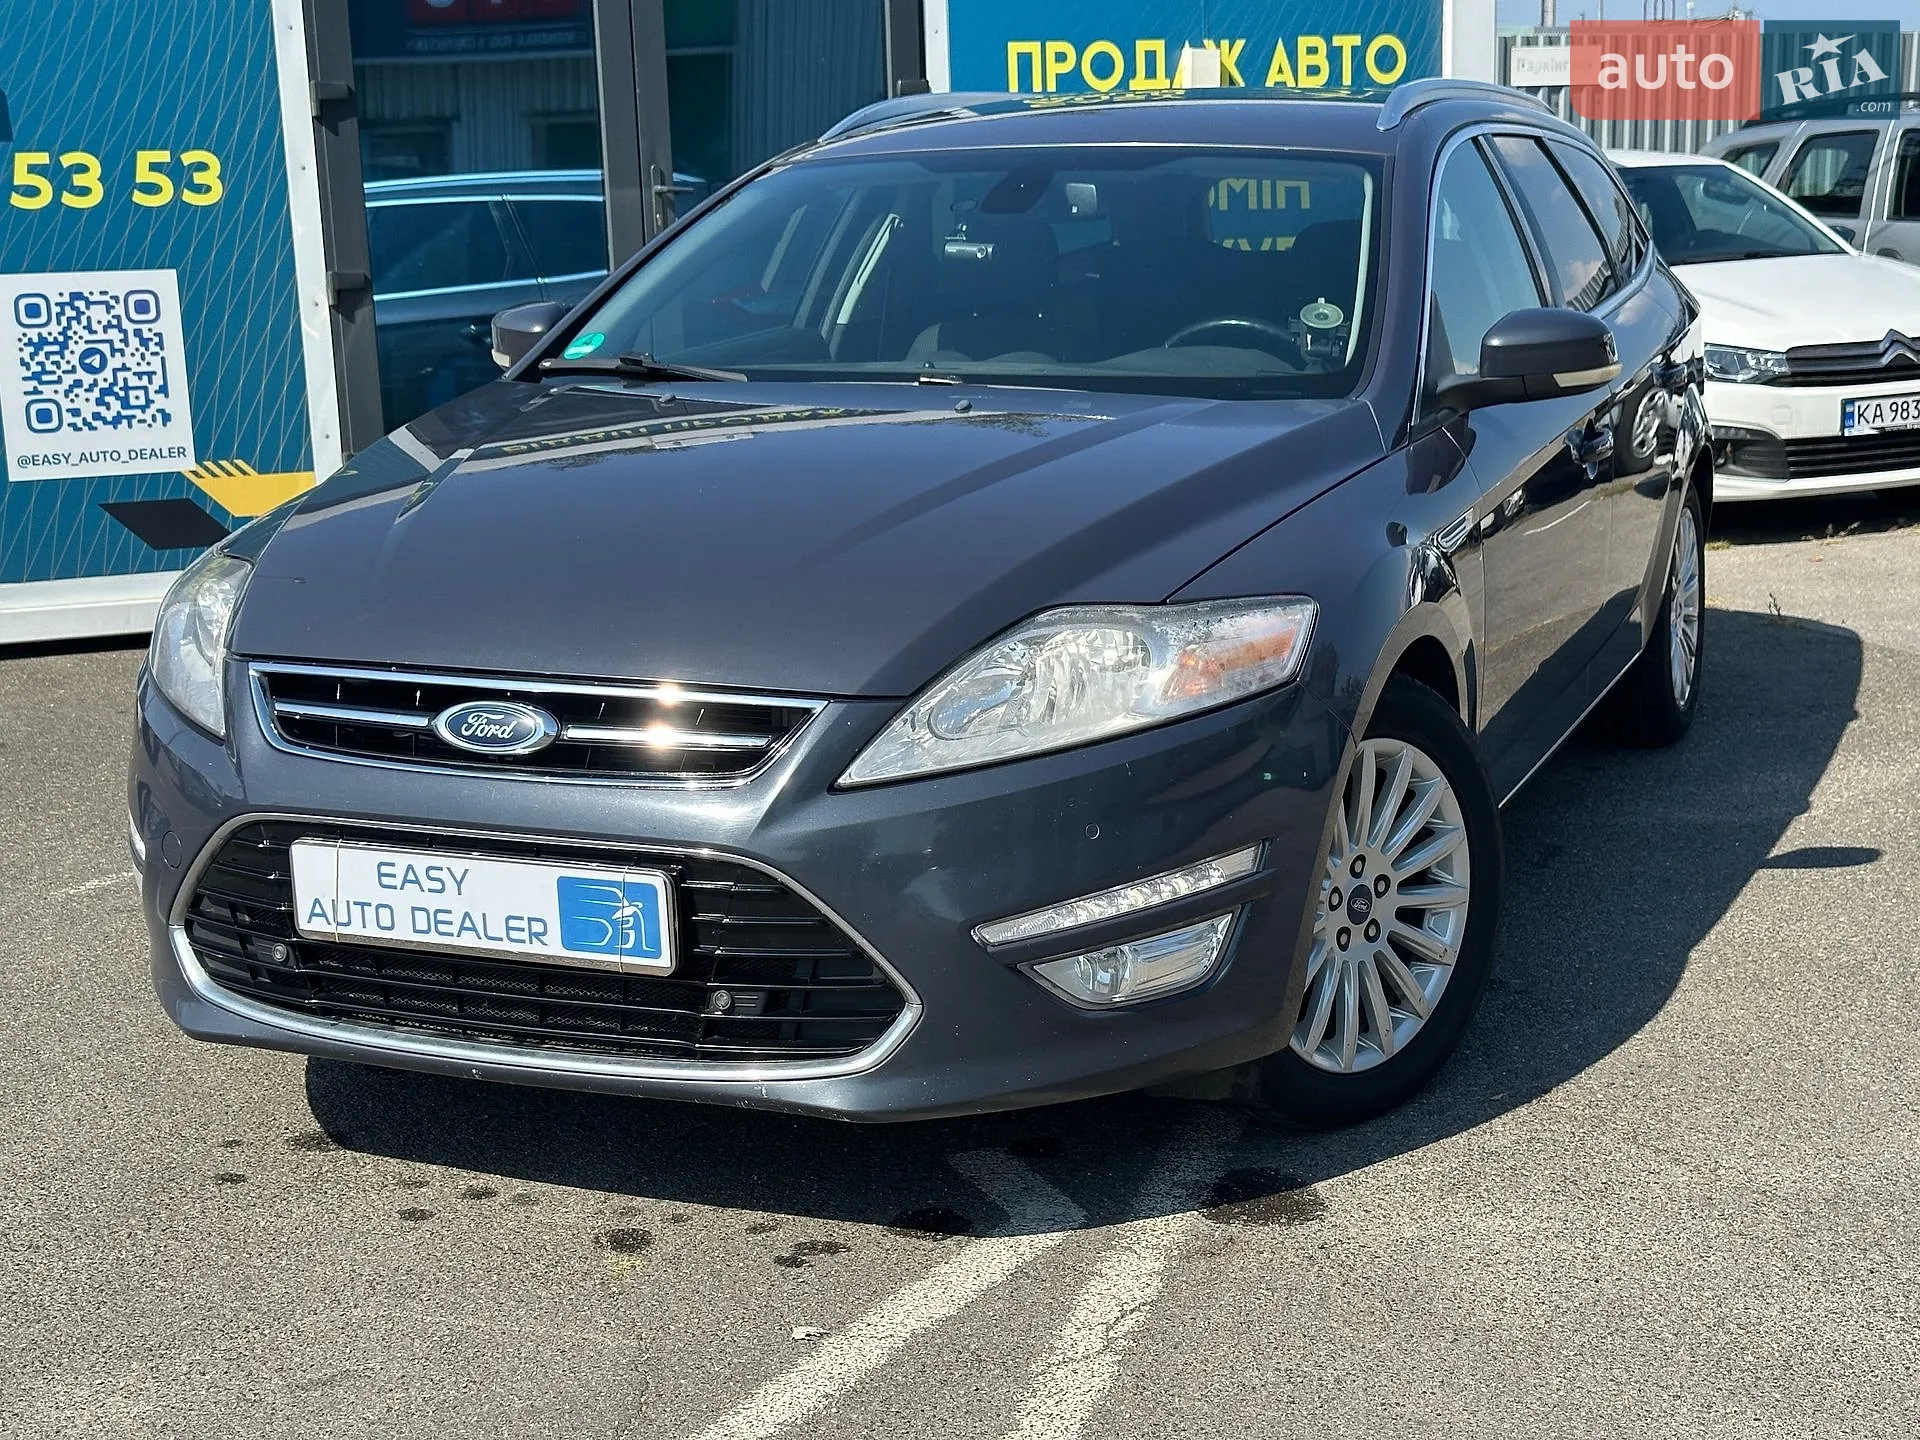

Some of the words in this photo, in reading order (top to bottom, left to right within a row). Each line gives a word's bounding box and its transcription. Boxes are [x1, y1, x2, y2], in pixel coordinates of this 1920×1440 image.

[1265, 34, 1407, 87] АВТО
[9, 151, 104, 210] 53
[131, 149, 223, 207] 53
[17, 446, 187, 468] @EASY_AUTO_DEALER
[461, 712, 517, 739] Ford
[377, 861, 469, 896] EASY
[307, 897, 395, 931] AUTO
[411, 906, 548, 946] DEALER
